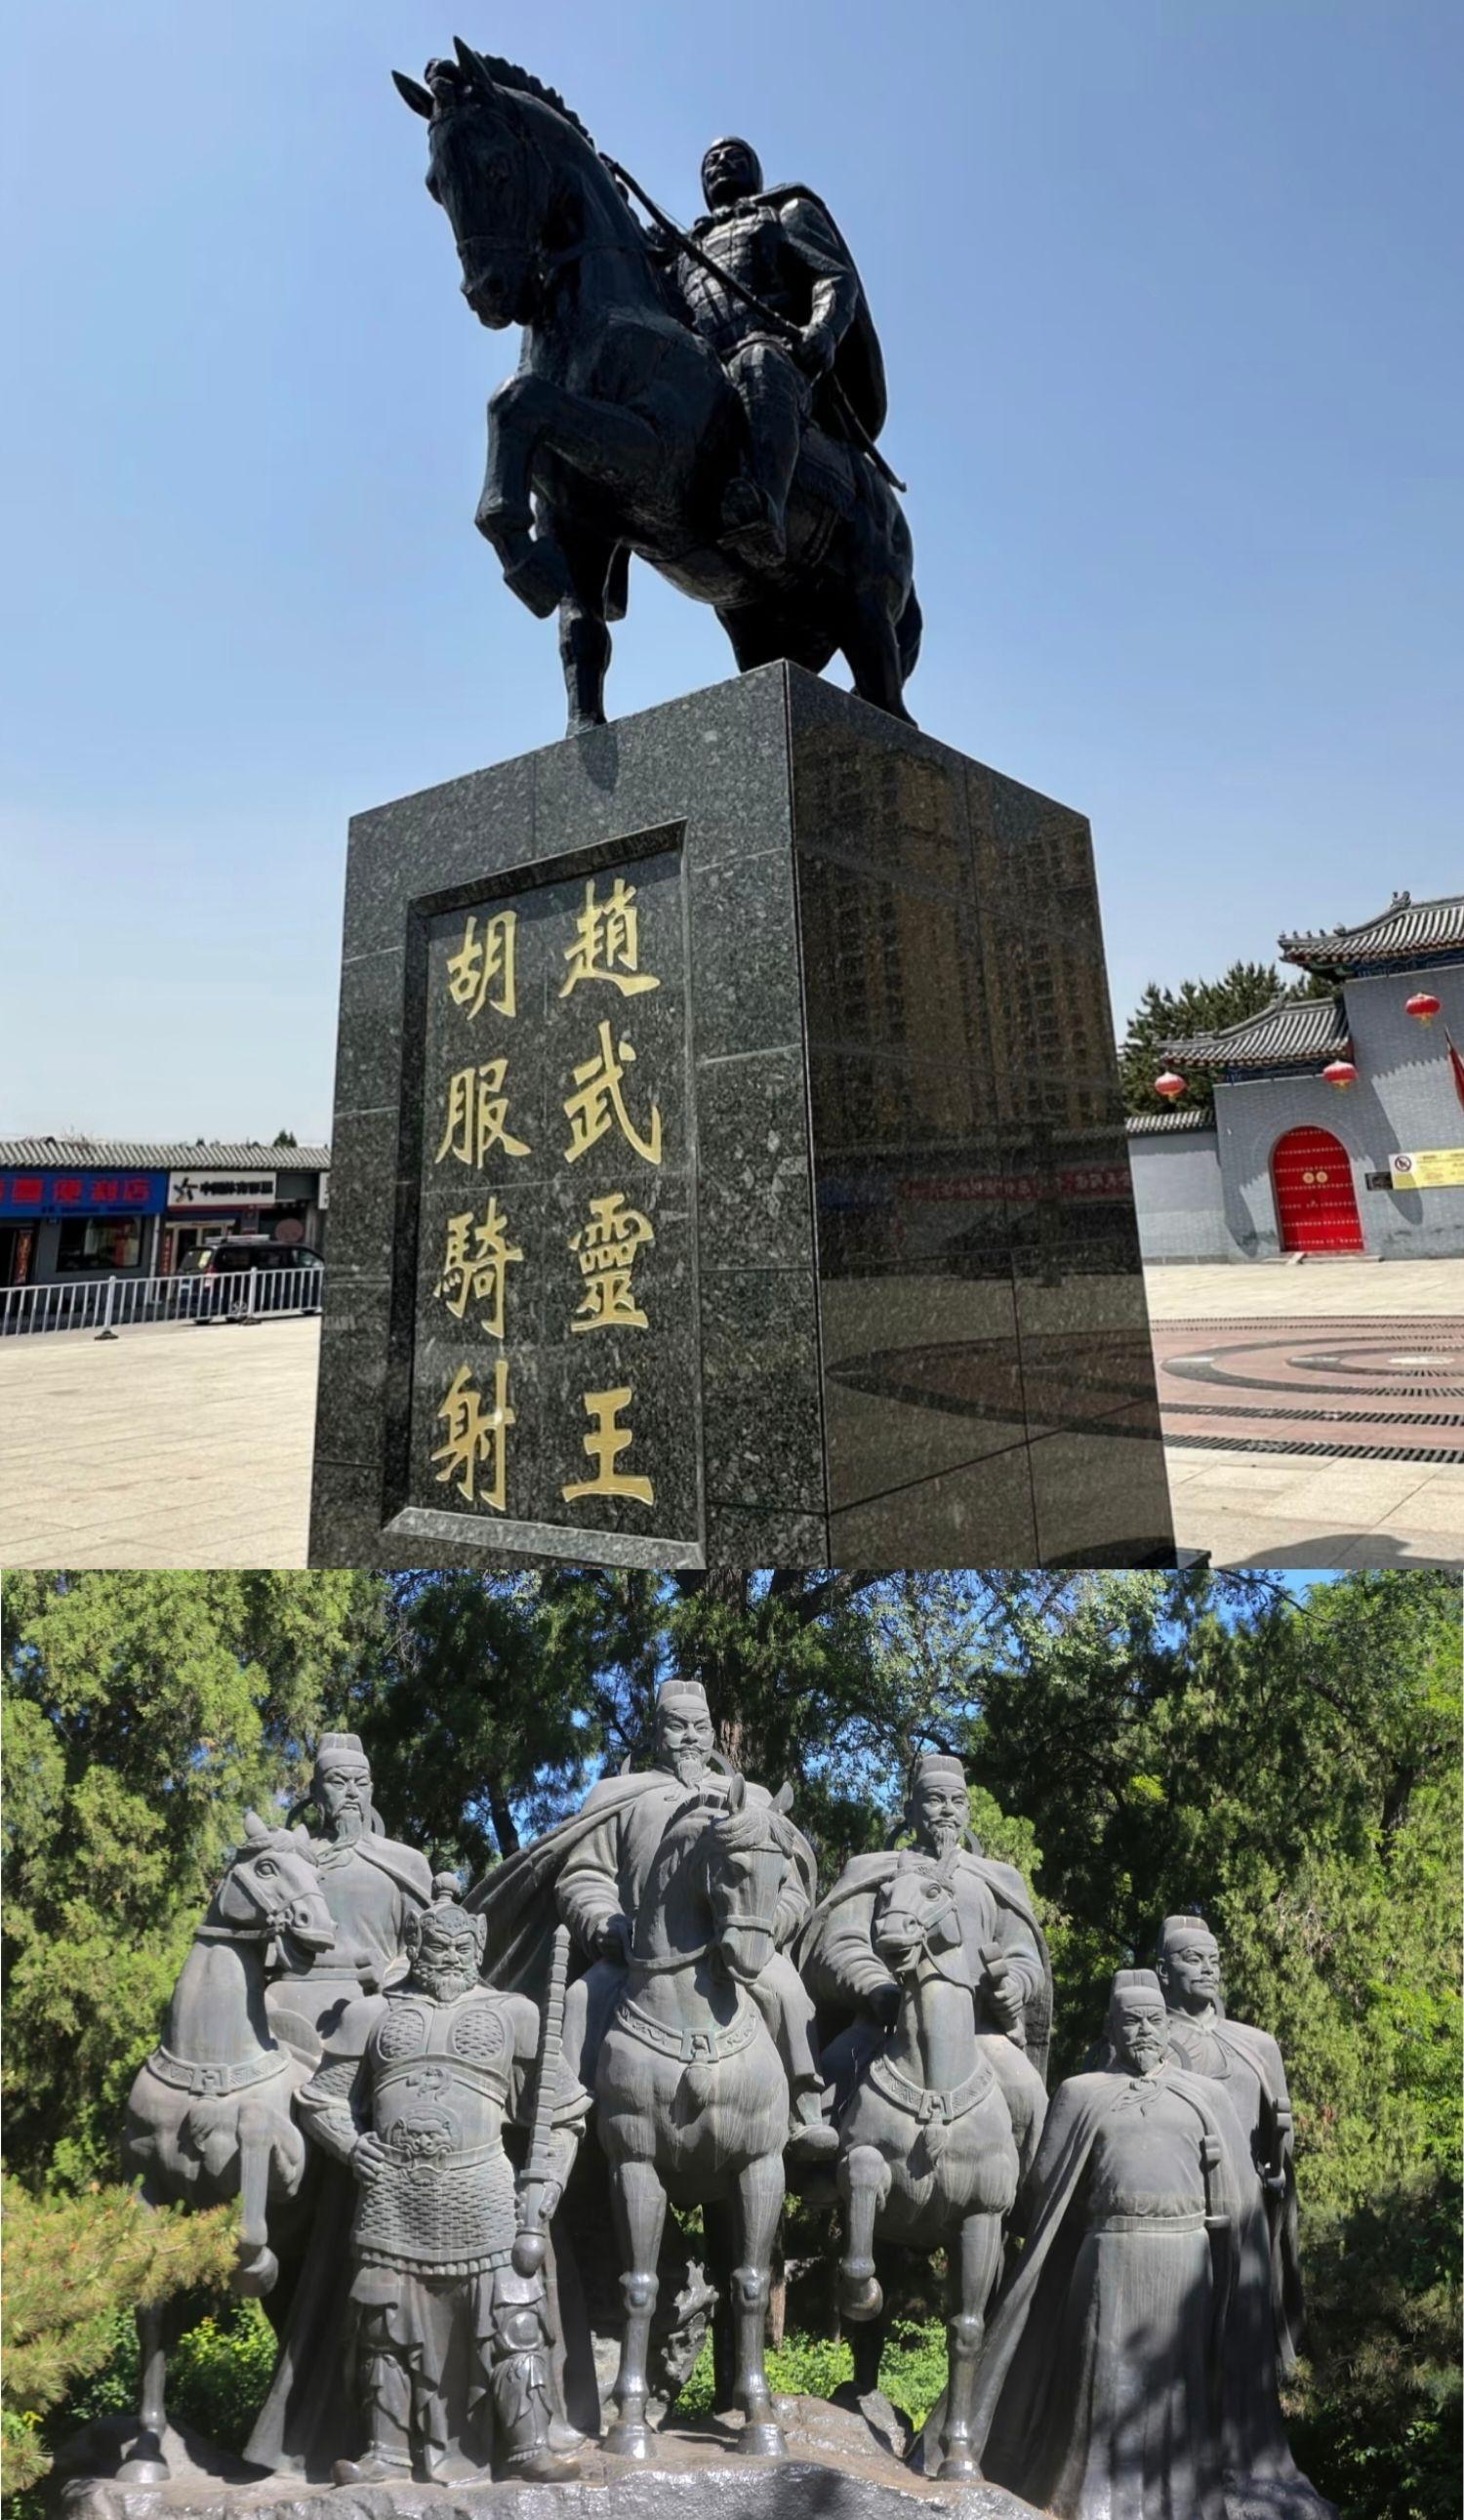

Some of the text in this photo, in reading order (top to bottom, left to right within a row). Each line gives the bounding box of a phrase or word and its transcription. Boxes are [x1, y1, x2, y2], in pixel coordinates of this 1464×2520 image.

[429, 909, 531, 1512] 胡服騎射
[558, 877, 663, 1506] 趙武靈王
